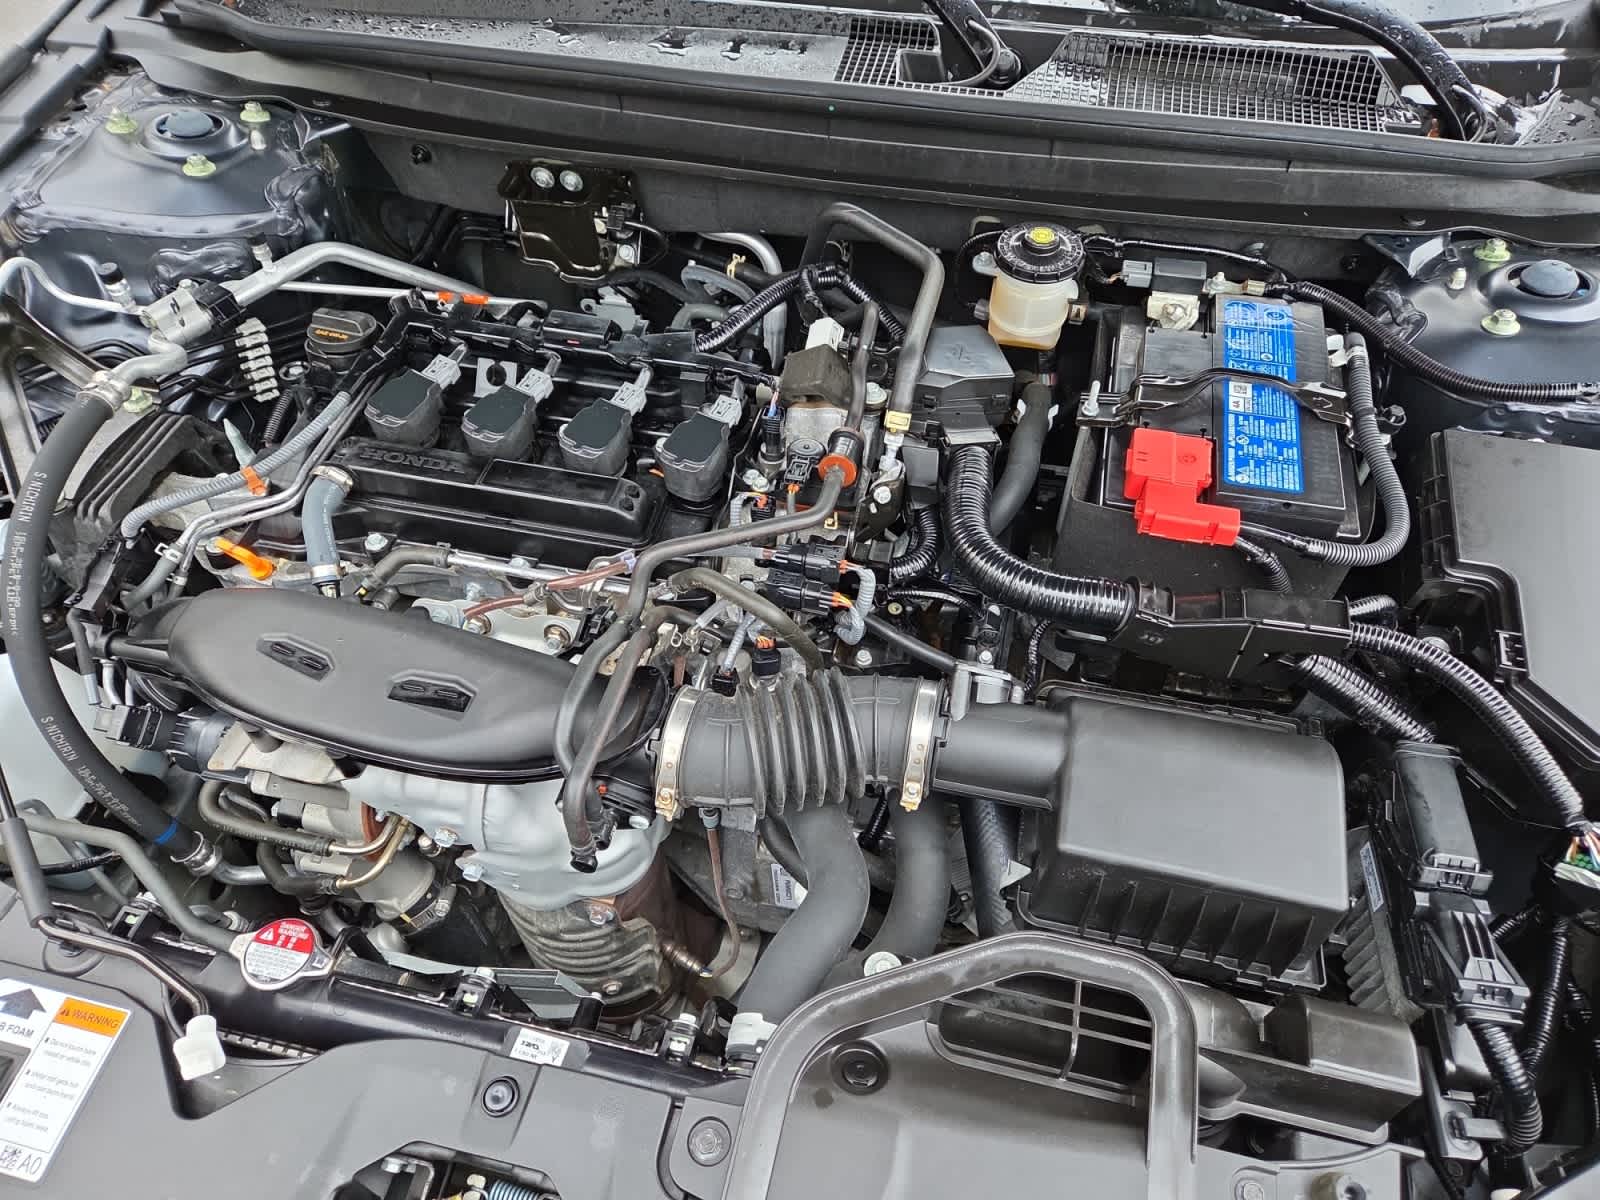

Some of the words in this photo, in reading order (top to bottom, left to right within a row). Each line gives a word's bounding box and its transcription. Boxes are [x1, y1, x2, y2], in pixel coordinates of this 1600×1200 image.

[360, 447, 466, 474] HONDA
[71, 1008, 120, 1029] WARNING
[7, 1023, 34, 1038] FOAM
